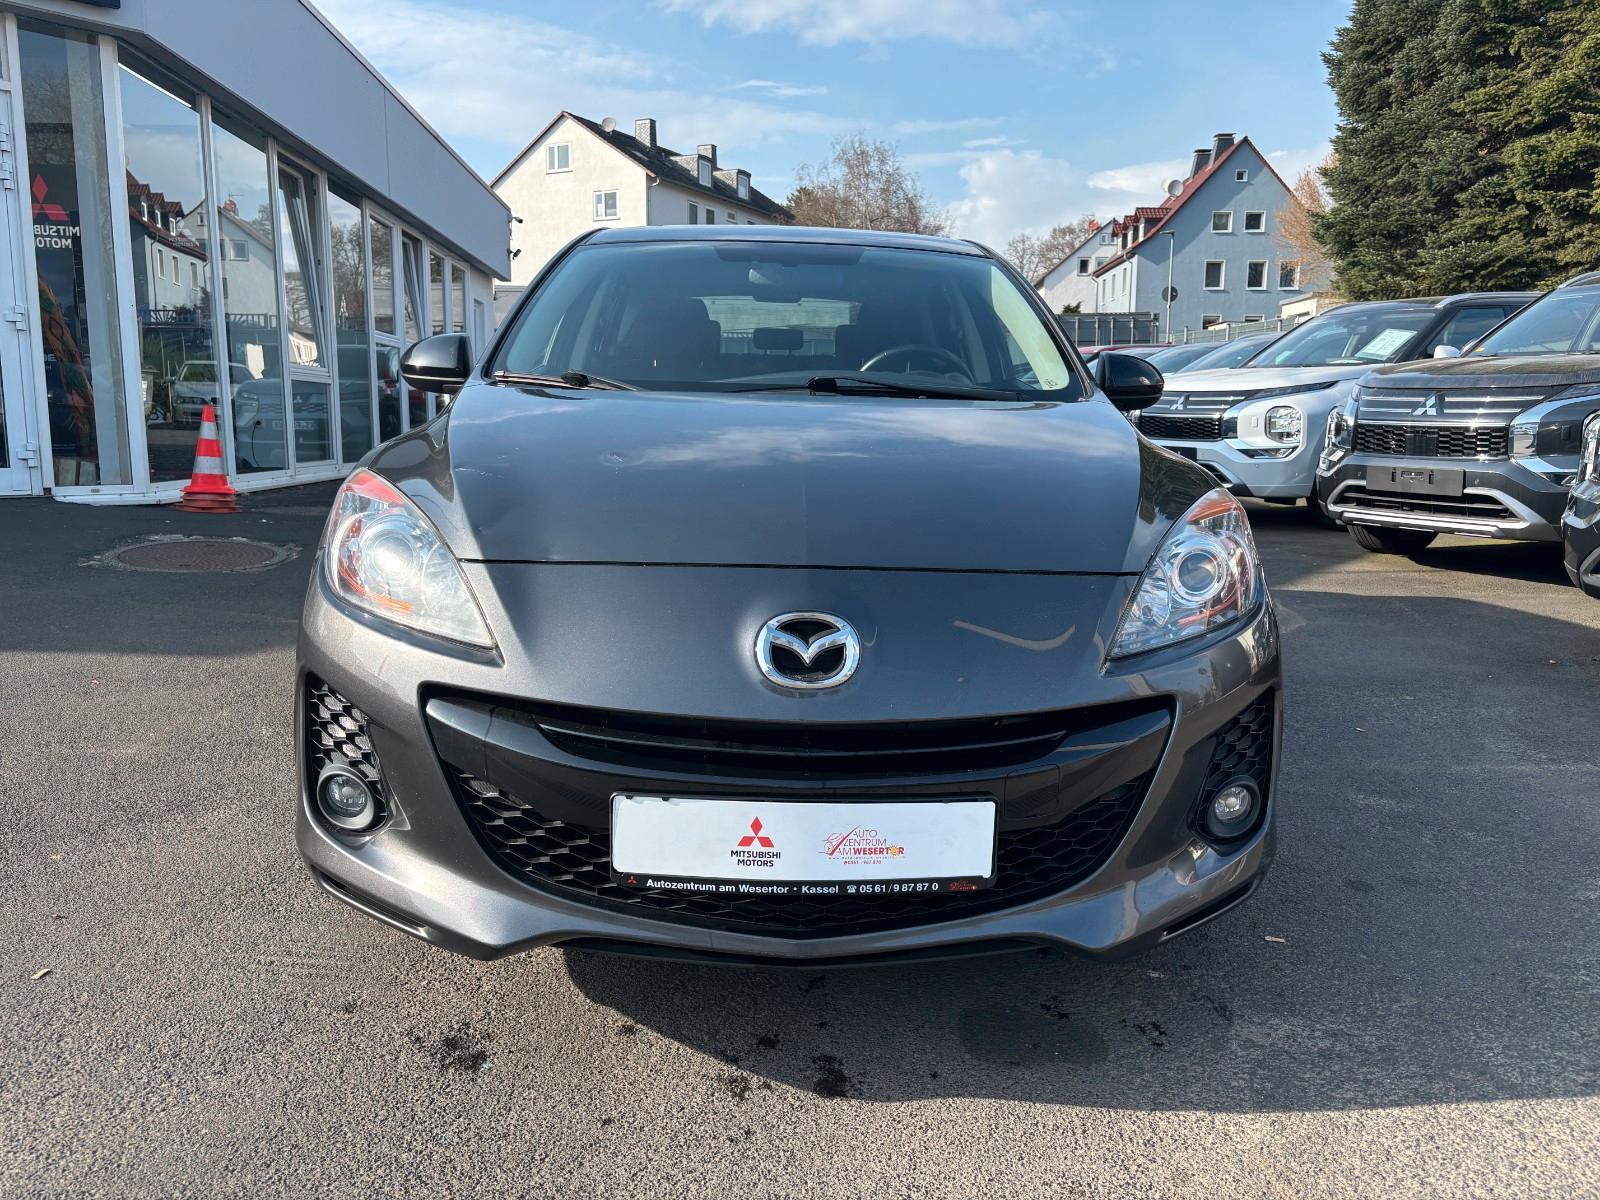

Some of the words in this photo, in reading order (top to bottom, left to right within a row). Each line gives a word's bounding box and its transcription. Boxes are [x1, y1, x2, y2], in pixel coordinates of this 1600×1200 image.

[853, 829, 878, 839] AUTO
[843, 838, 887, 847] ZENTRUM
[730, 850, 781, 860] MITSUBISHI
[737, 858, 775, 867] MOTORS
[646, 879, 716, 892] Autozentrum
[718, 884, 736, 893] am
[738, 883, 789, 894] Wesertor
[801, 884, 839, 894] Kassel
